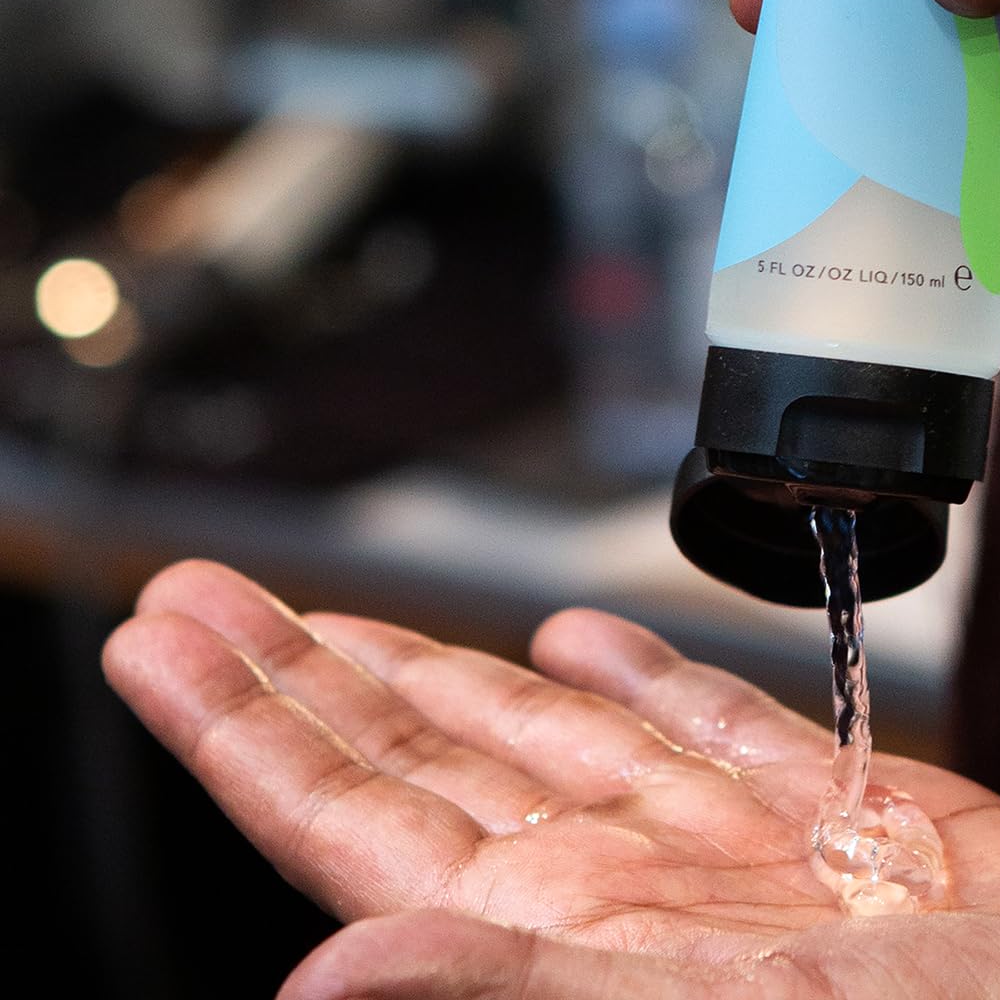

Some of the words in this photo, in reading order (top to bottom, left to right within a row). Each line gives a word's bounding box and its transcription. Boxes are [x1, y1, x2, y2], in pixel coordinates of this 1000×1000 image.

[757, 259, 765, 273] 5
[769, 261, 786, 276] FL
[929, 275, 946, 289] ml
